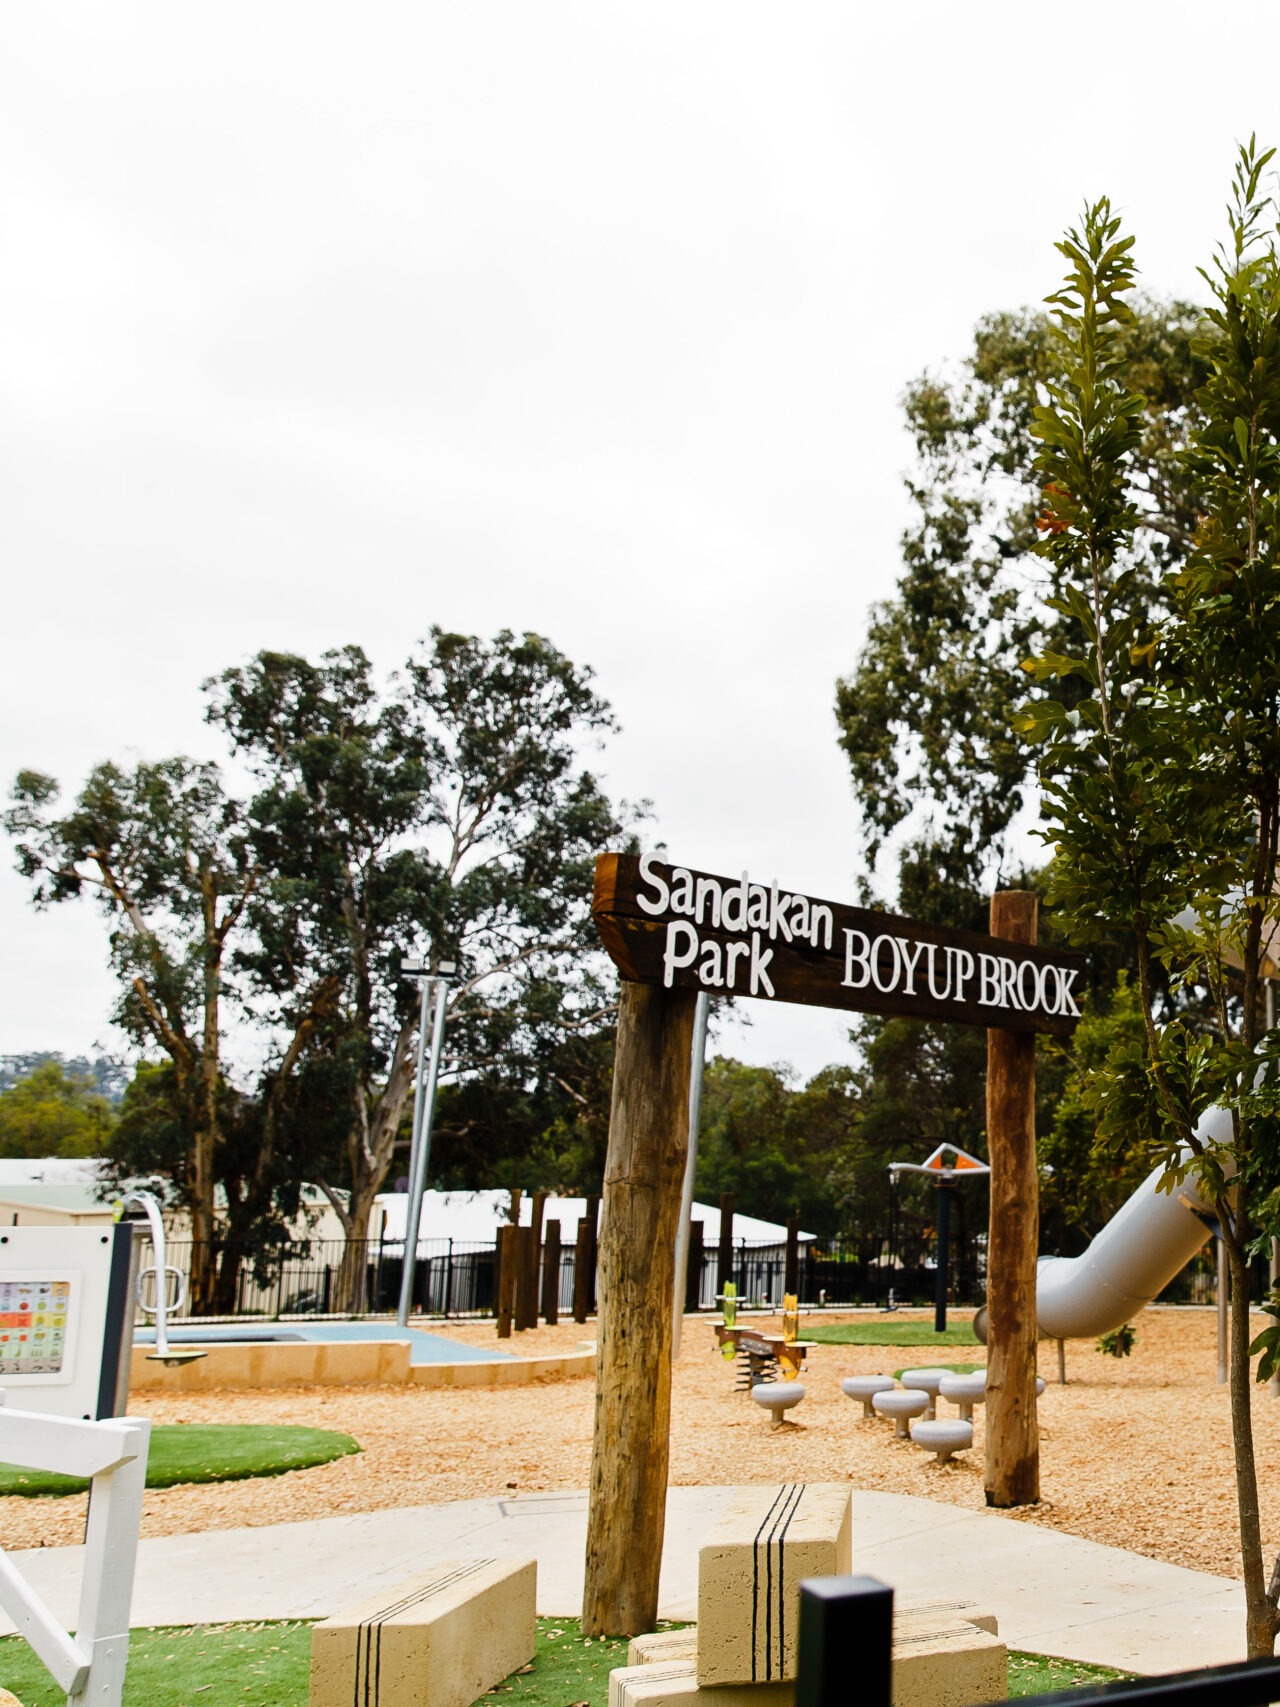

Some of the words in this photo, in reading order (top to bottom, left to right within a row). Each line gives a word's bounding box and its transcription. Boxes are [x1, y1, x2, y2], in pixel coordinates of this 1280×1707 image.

[636, 851, 833, 950] Sandakan
[663, 920, 775, 998] Park
[841, 928, 974, 1002] BOYUP
[977, 952, 1082, 1018] BROOK
